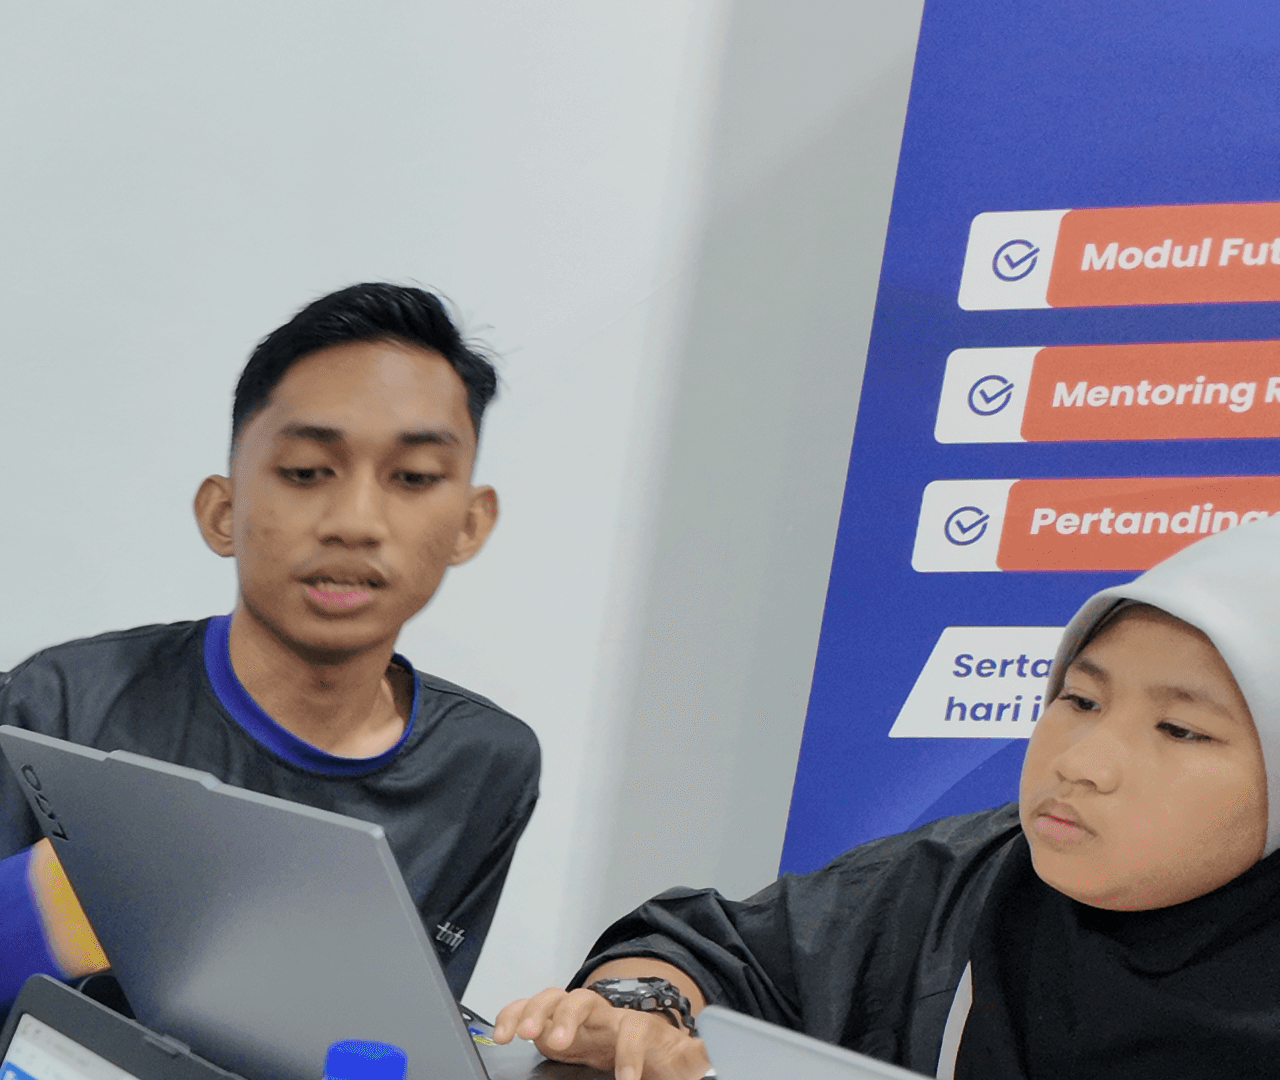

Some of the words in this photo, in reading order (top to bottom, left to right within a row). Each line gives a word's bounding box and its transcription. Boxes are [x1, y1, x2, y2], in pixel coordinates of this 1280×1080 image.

[1080, 238, 1209, 271] Modul
[1052, 376, 1257, 413] Mentoring
[1030, 502, 1280, 535] Pertandin
[952, 653, 1053, 678] Serta
[944, 694, 1023, 722] hari
